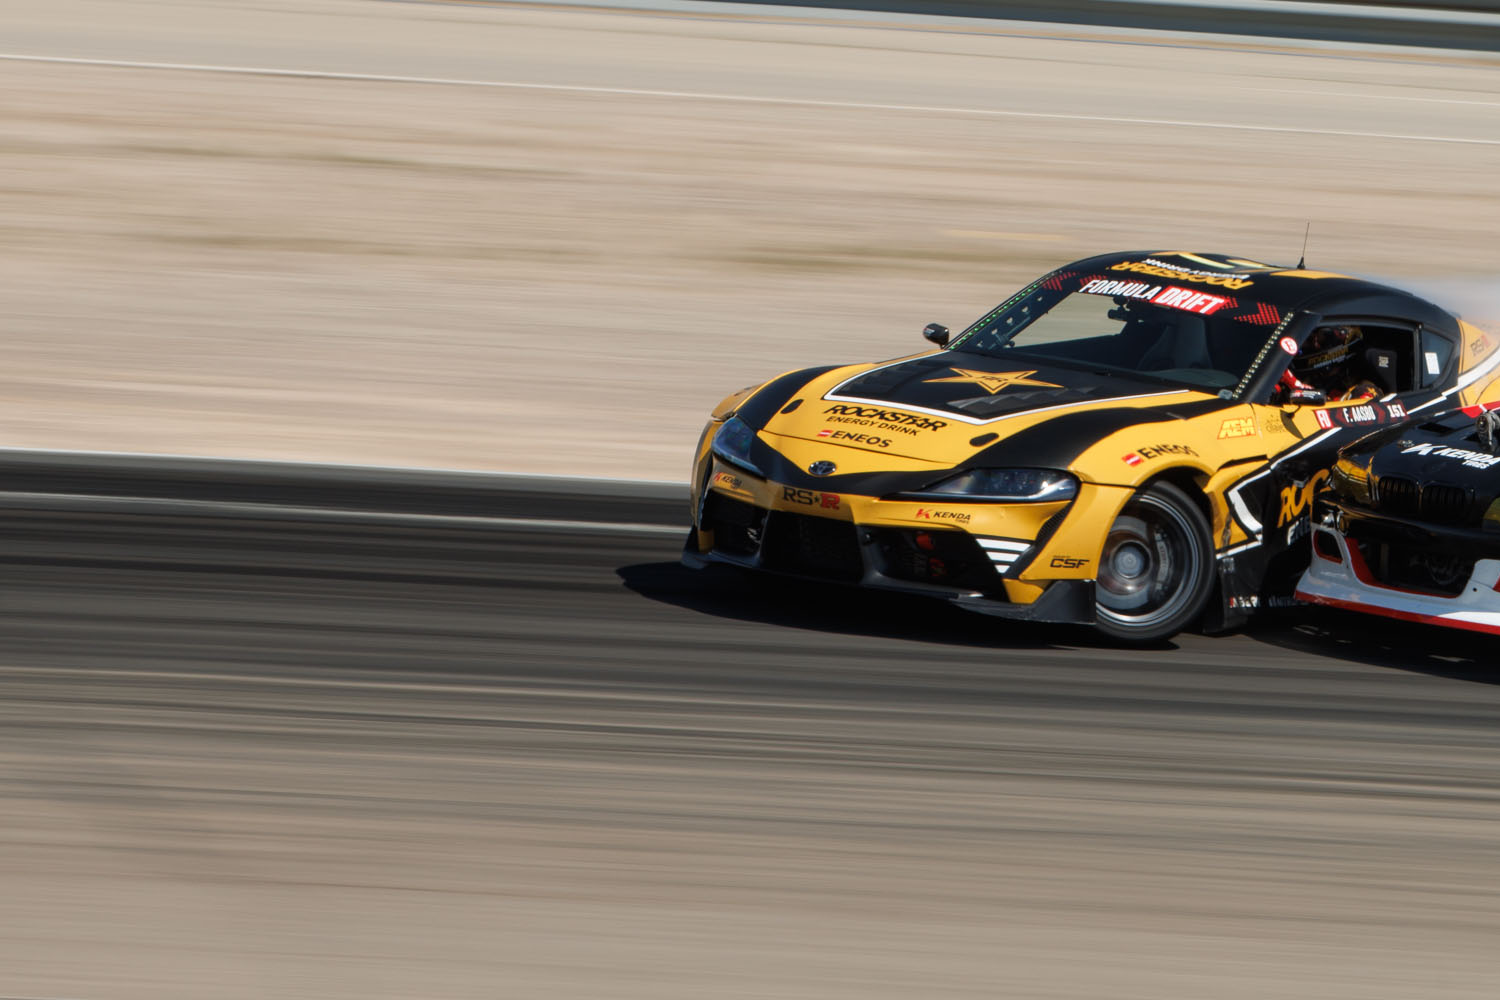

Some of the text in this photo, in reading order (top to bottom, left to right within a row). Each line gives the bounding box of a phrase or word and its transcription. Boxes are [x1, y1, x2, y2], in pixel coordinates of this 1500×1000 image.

[1110, 261, 1254, 290] ROCKSTAR
[1079, 279, 1225, 314] FORMULA DRIFT
[823, 404, 948, 432] ROCKSTAR
[826, 416, 921, 437] ENERGY DRINK
[1315, 410, 1331, 429] FD
[1387, 404, 1406, 418] 151
[1220, 418, 1256, 438] AEM
[831, 430, 893, 448] ENEOS
[1138, 443, 1200, 460] ENEOS
[933, 511, 971, 521] KENDA
[1050, 558, 1090, 569] CSF
